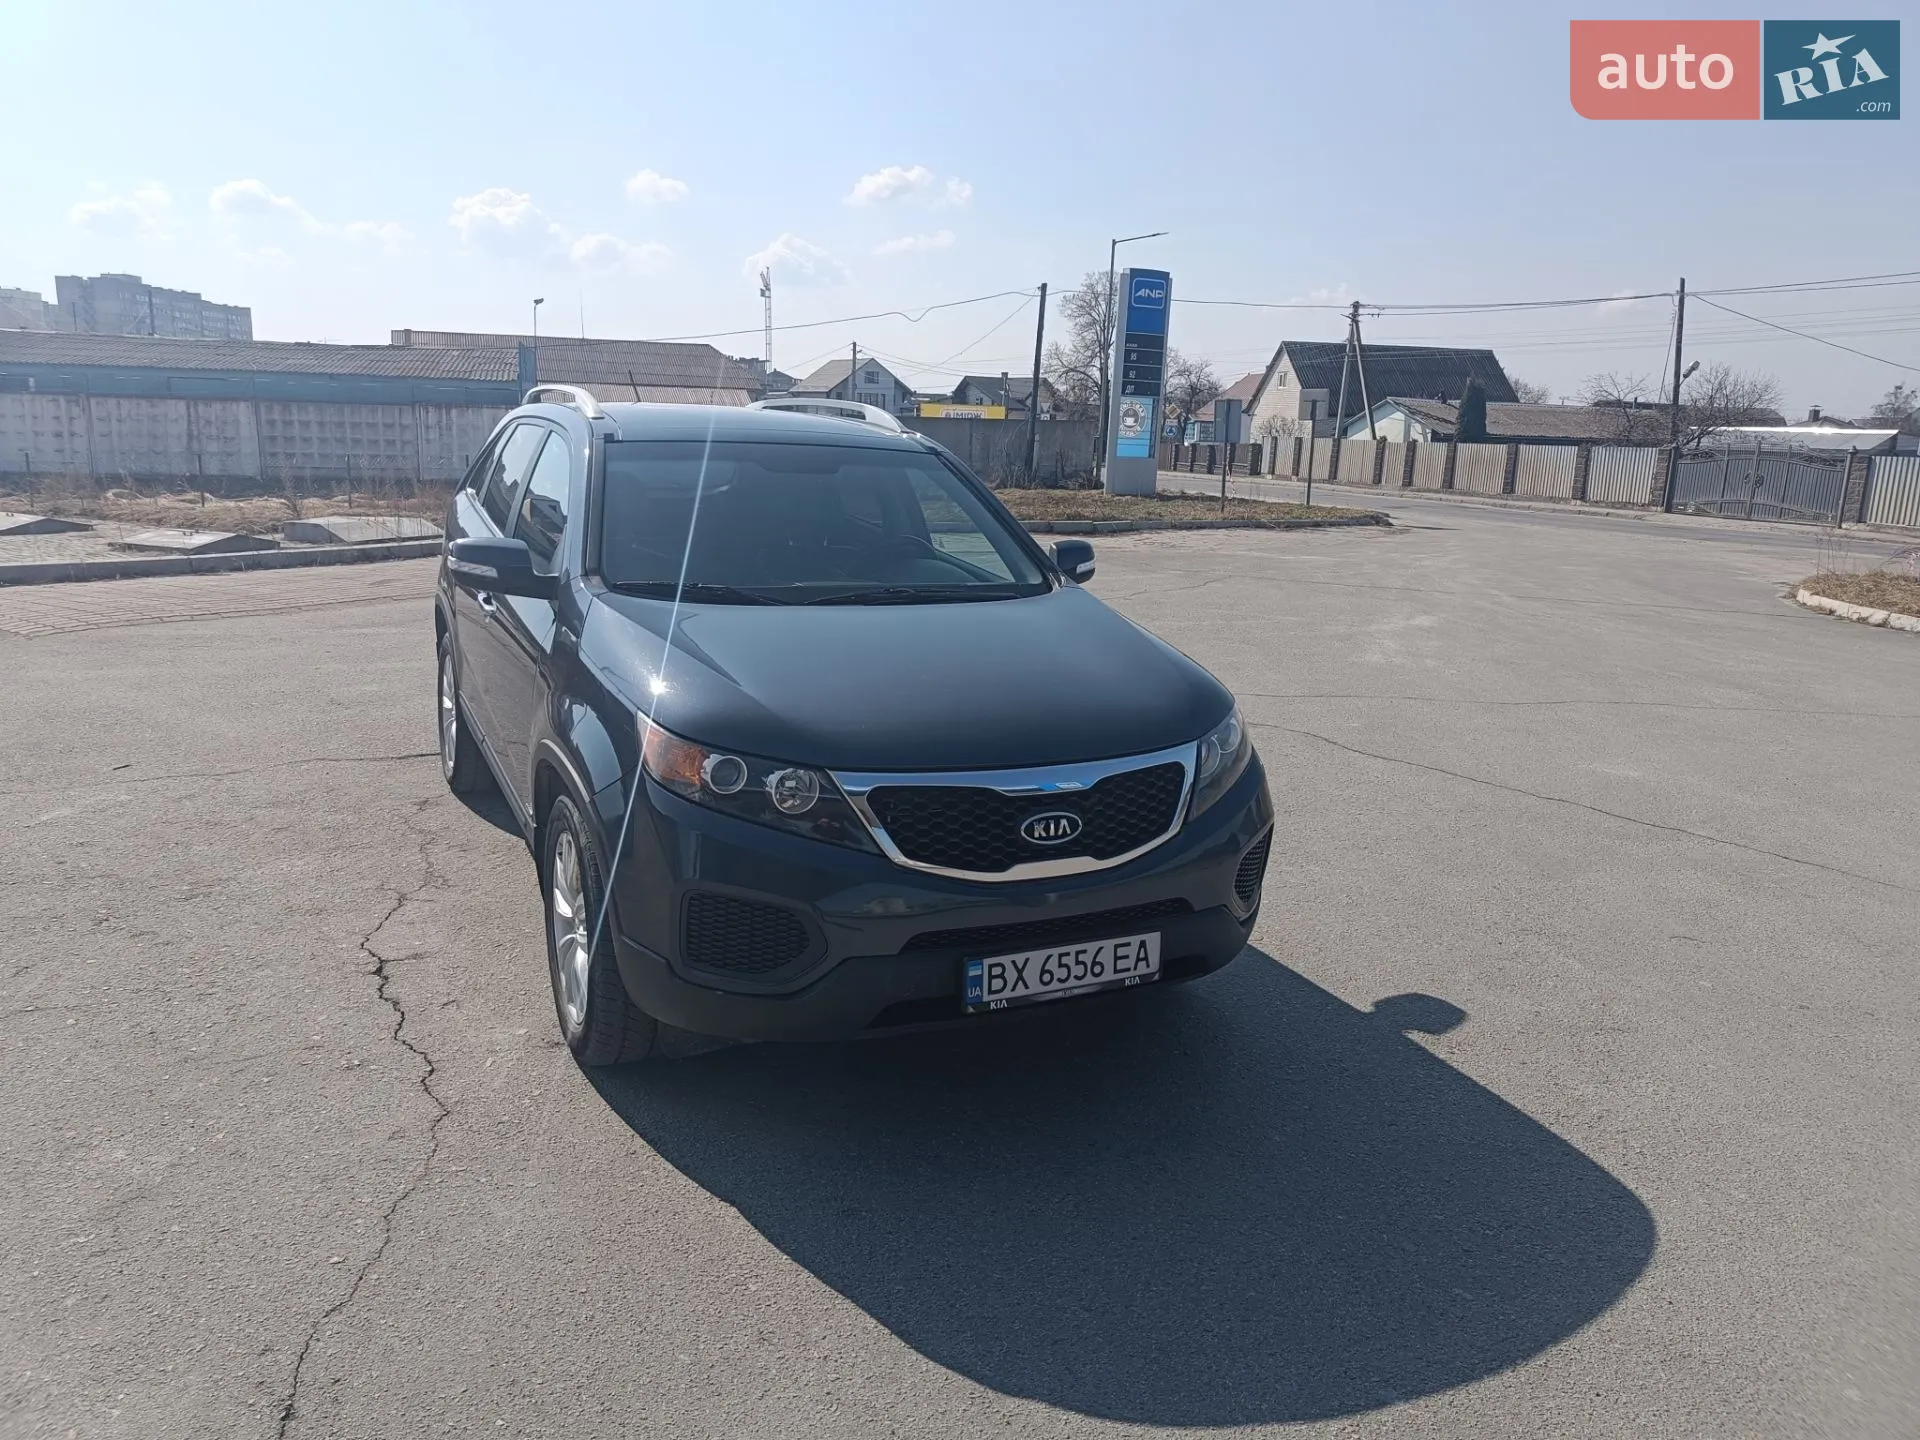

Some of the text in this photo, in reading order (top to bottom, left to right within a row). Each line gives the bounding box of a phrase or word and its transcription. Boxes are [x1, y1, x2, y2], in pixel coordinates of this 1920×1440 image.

[1135, 288, 1164, 299] ANP
[1033, 818, 1072, 838] KIA
[987, 939, 1151, 996] BX 6556 EA
[1124, 976, 1141, 987] KIA
[967, 986, 982, 998] UA
[990, 1000, 1008, 1010] KIA
